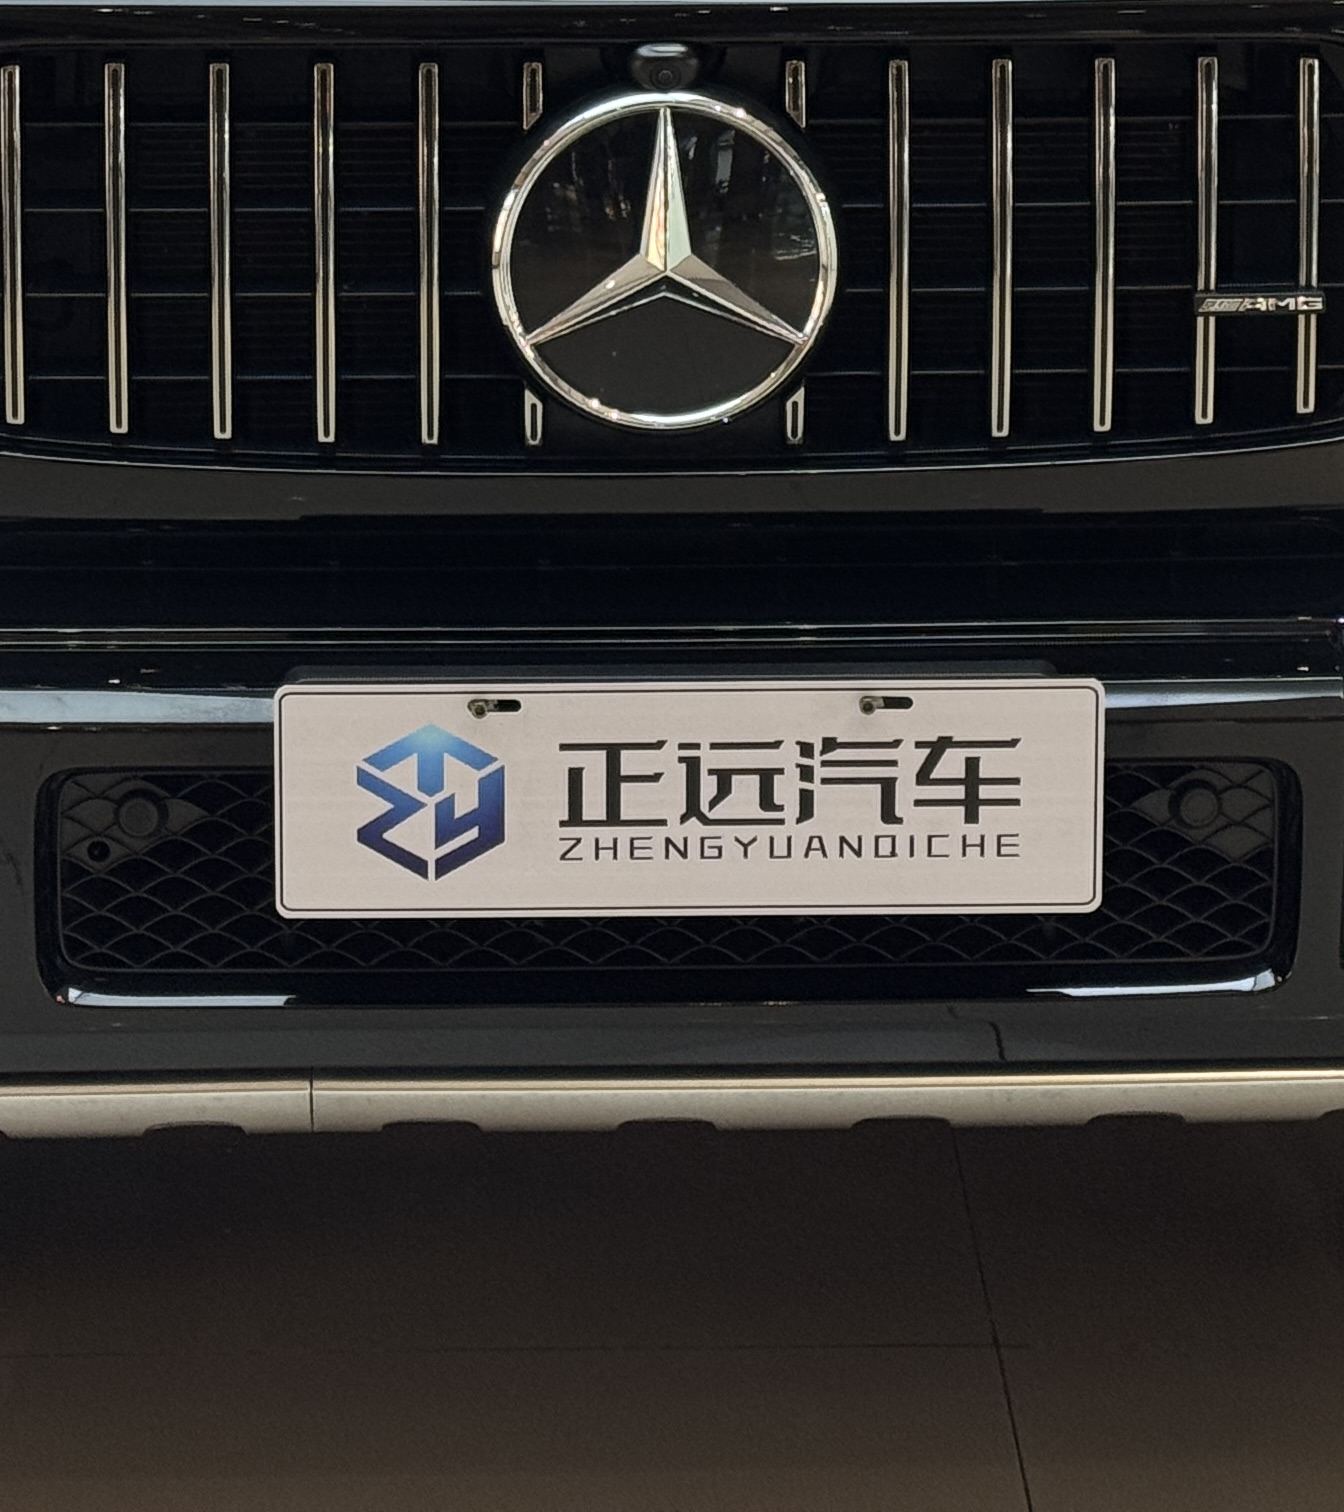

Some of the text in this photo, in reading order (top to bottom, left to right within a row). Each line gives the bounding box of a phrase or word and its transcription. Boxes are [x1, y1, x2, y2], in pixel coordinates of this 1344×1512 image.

[558, 737, 1022, 828] 正远汽车
[558, 833, 1021, 862] ZHENGYUANQICHE
